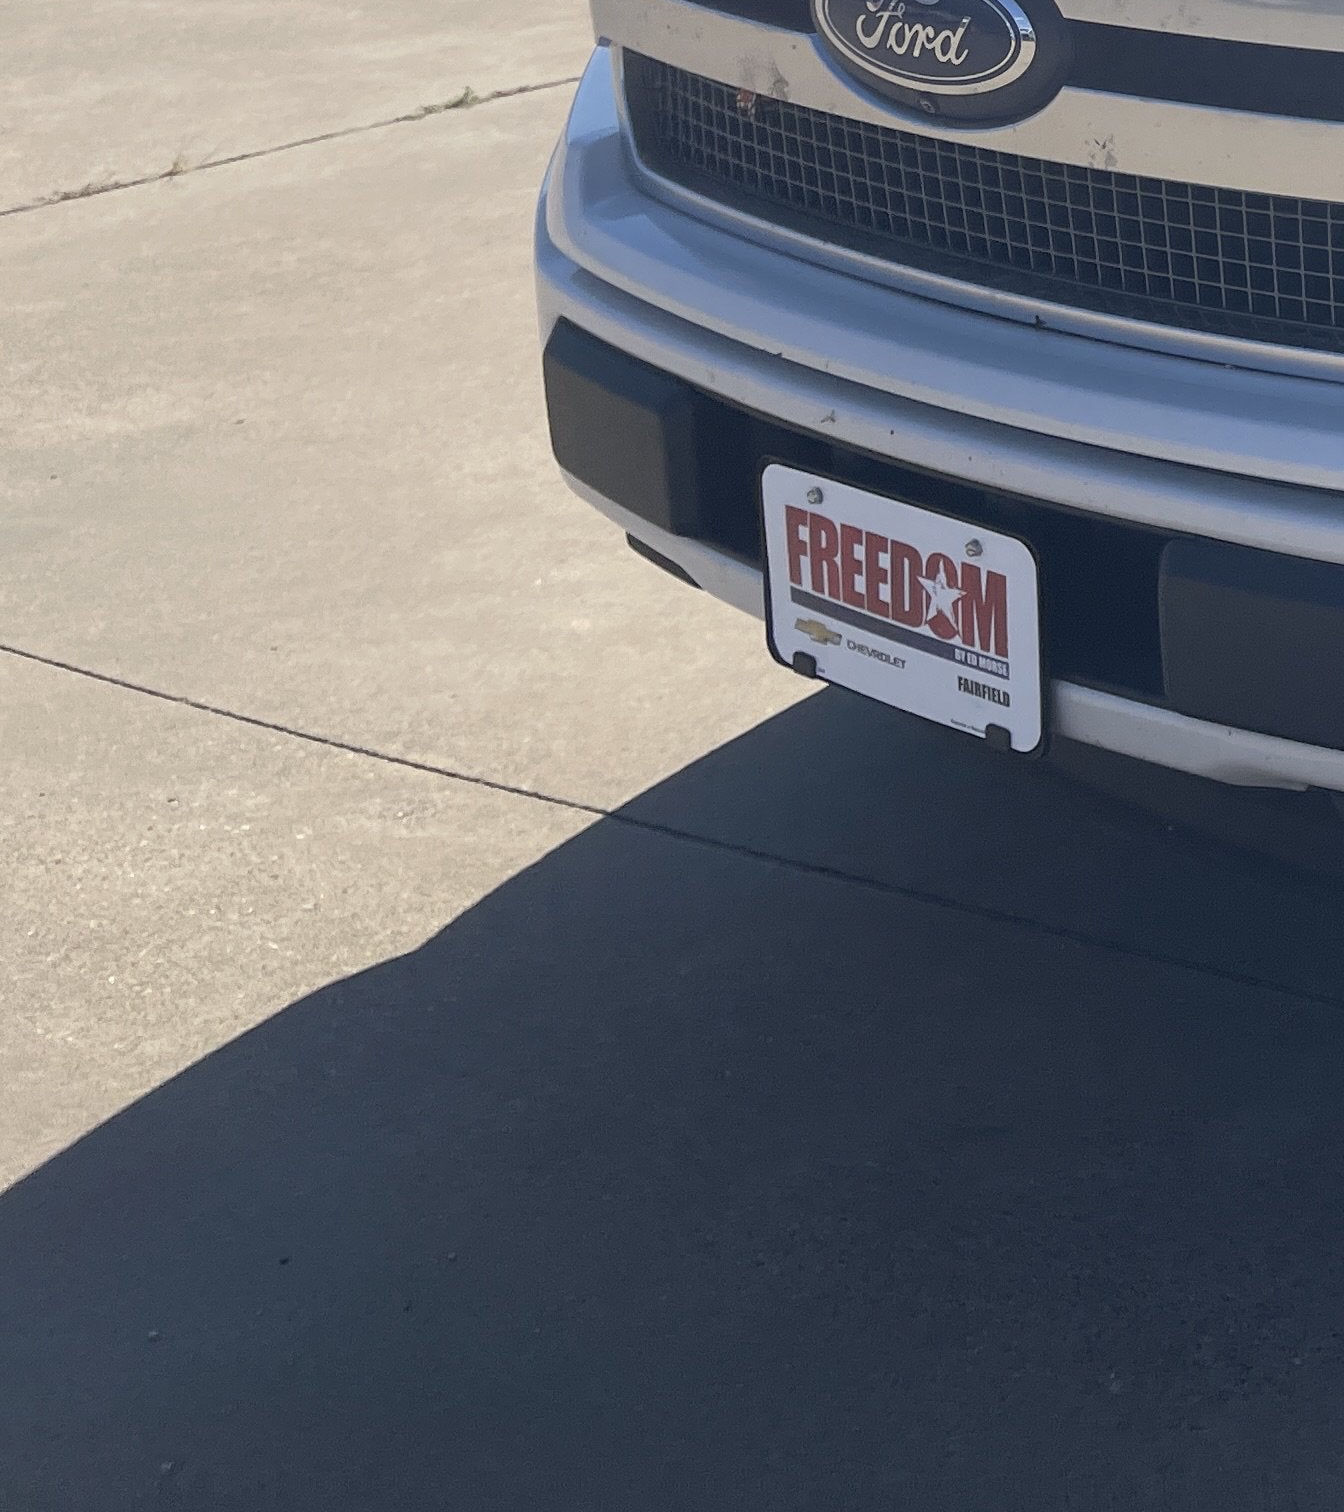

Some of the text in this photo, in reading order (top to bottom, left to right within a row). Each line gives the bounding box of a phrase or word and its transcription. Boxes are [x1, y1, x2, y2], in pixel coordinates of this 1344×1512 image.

[785, 504, 1009, 659] FREEDOM
[846, 639, 907, 669] CHEVROLET
[954, 648, 966, 662] BY
[957, 675, 1010, 707] FAIRFIELD
